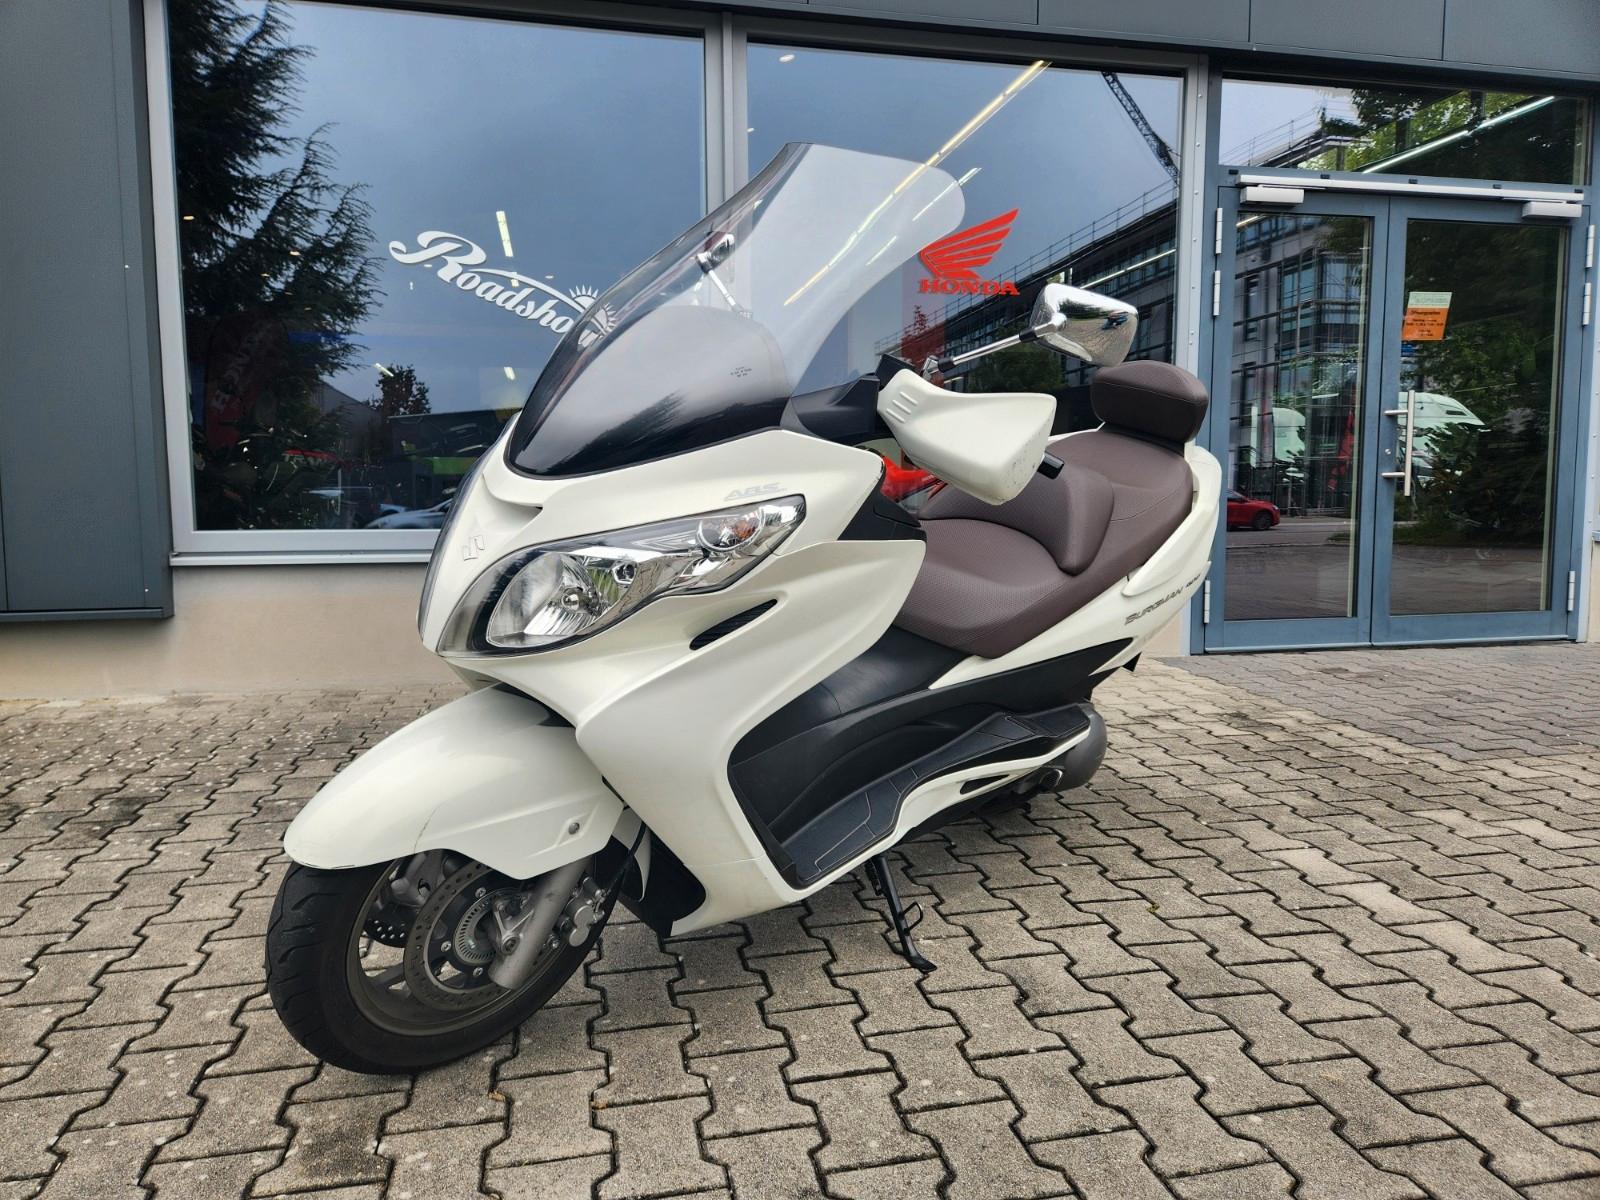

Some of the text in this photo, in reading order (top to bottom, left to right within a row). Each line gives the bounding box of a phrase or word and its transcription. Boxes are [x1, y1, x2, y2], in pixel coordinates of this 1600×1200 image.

[389, 230, 590, 341] Roadsho
[918, 278, 1021, 296] HONDA
[724, 482, 783, 501] ABS
